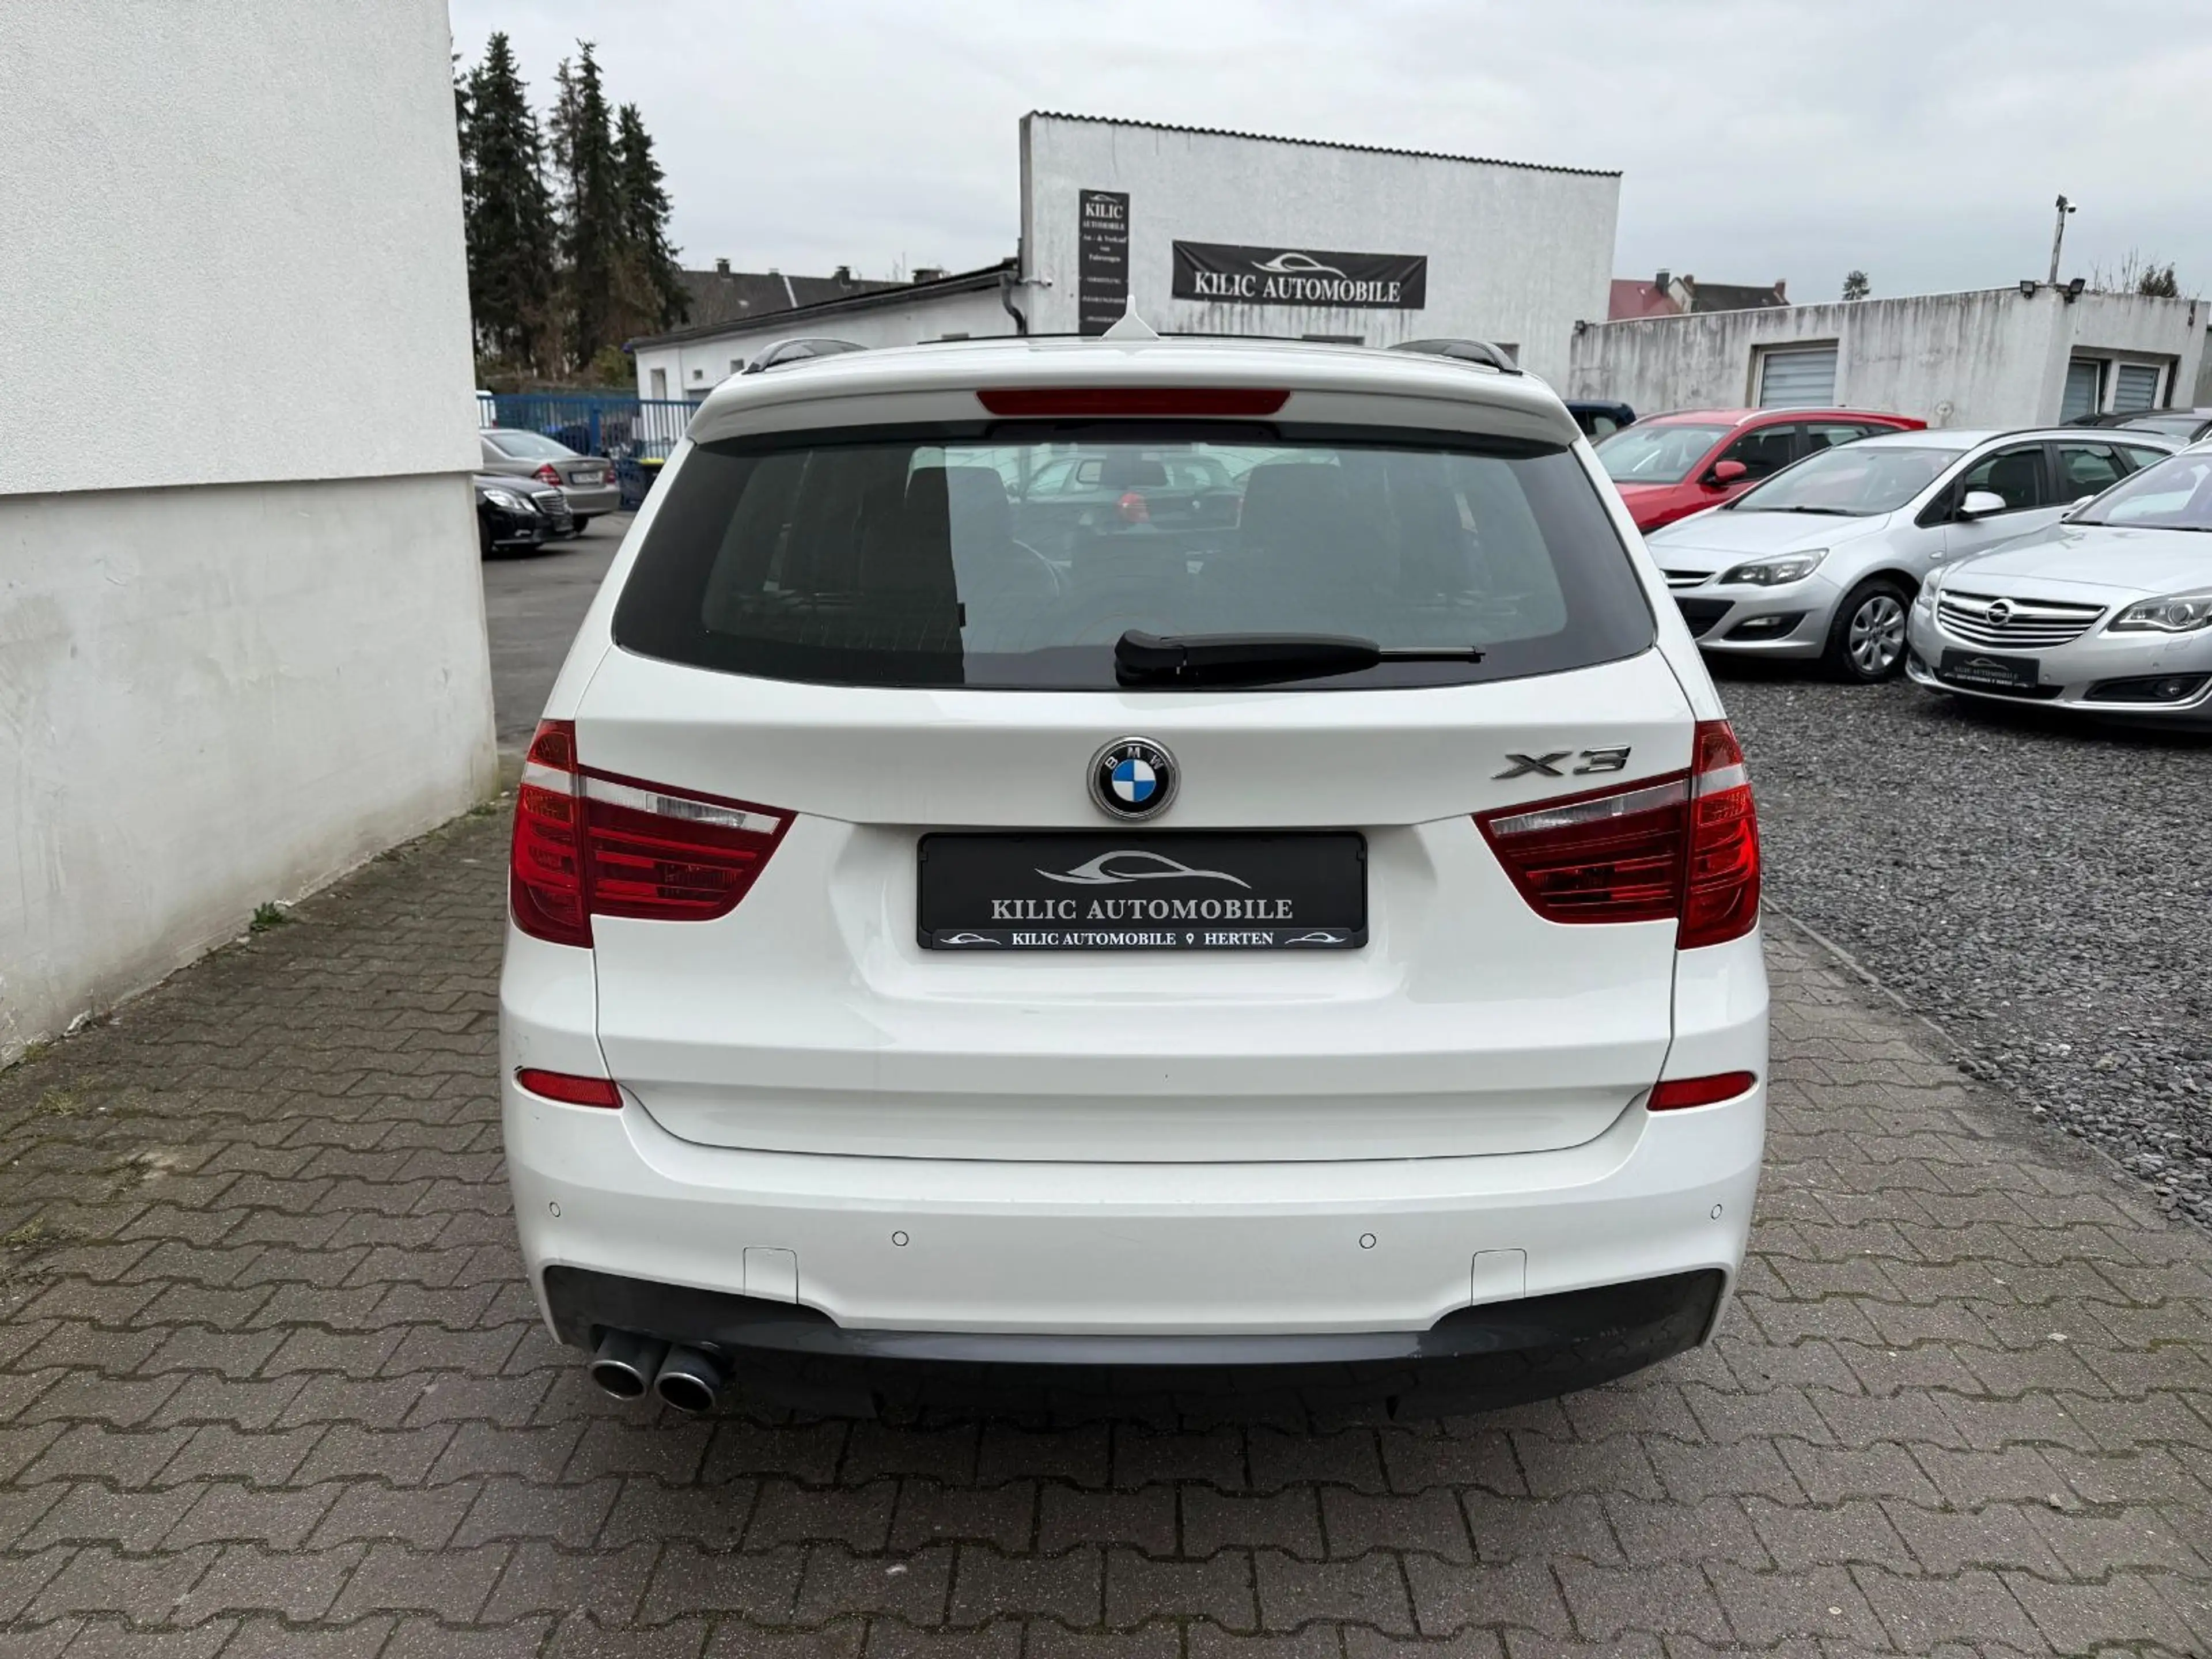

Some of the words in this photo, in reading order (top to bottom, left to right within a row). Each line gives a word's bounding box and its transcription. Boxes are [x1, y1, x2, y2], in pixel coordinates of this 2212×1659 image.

[1085, 203, 1123, 219] KILIC
[1195, 271, 1256, 297] KILIC
[1263, 278, 1401, 302] AUTOMOBILE
[1105, 747, 1164, 770] BMW
[1491, 746, 1631, 779] X3
[991, 899, 1077, 919] KILIC
[1086, 899, 1293, 919] AUTOMOBILE
[1012, 932, 1059, 945] KILIC
[1062, 932, 1176, 945] AUTOMOBILE
[1204, 932, 1274, 945] HERTEN
